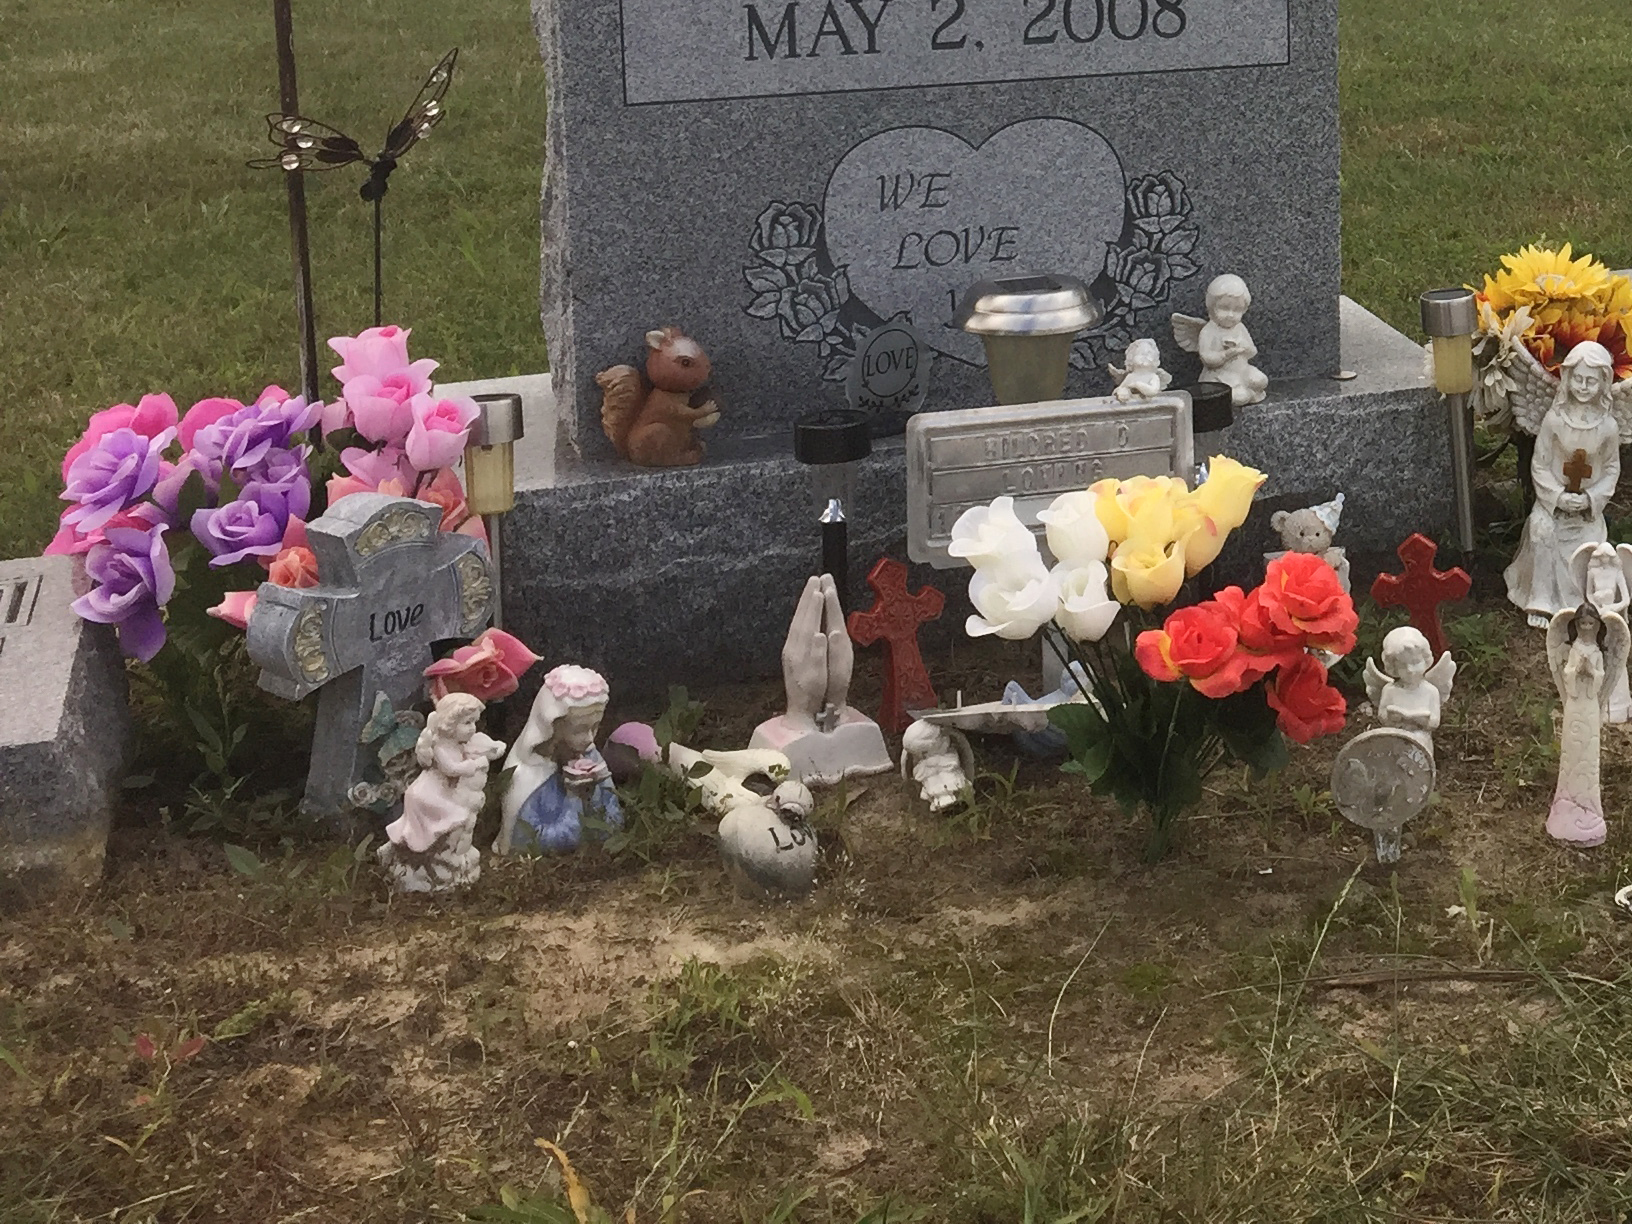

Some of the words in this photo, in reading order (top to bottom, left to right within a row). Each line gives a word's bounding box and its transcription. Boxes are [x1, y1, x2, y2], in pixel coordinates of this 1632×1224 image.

[876, 173, 953, 212] WE
[892, 226, 1020, 270] LOVE
[865, 346, 914, 377] LOVE
[369, 603, 424, 644] Love
